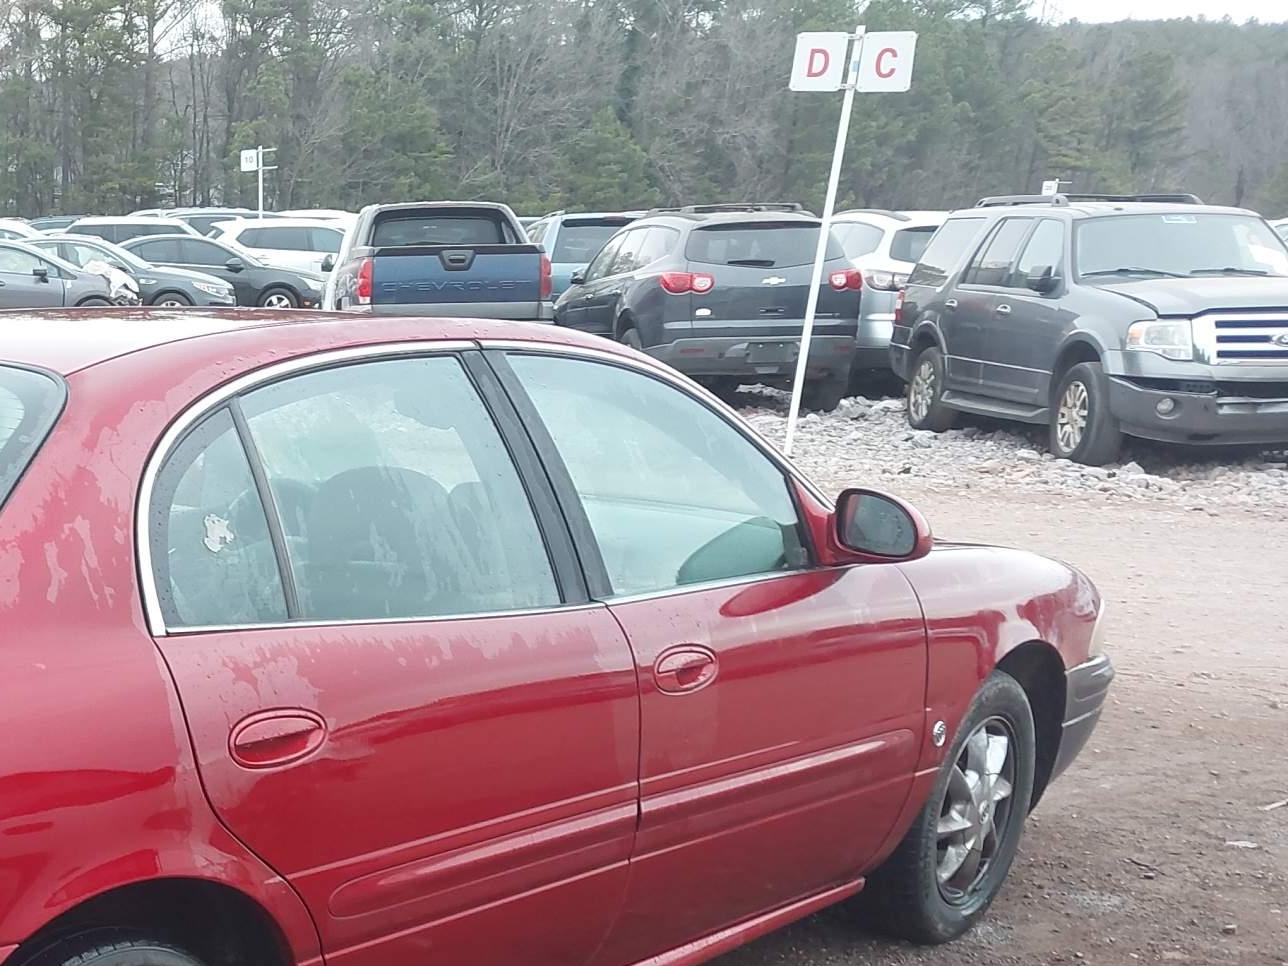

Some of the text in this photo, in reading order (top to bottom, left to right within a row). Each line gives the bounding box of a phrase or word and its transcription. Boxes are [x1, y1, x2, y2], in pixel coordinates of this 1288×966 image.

[806, 48, 830, 78] D
[875, 47, 899, 79] C
[381, 279, 533, 292] CHEVROLET
